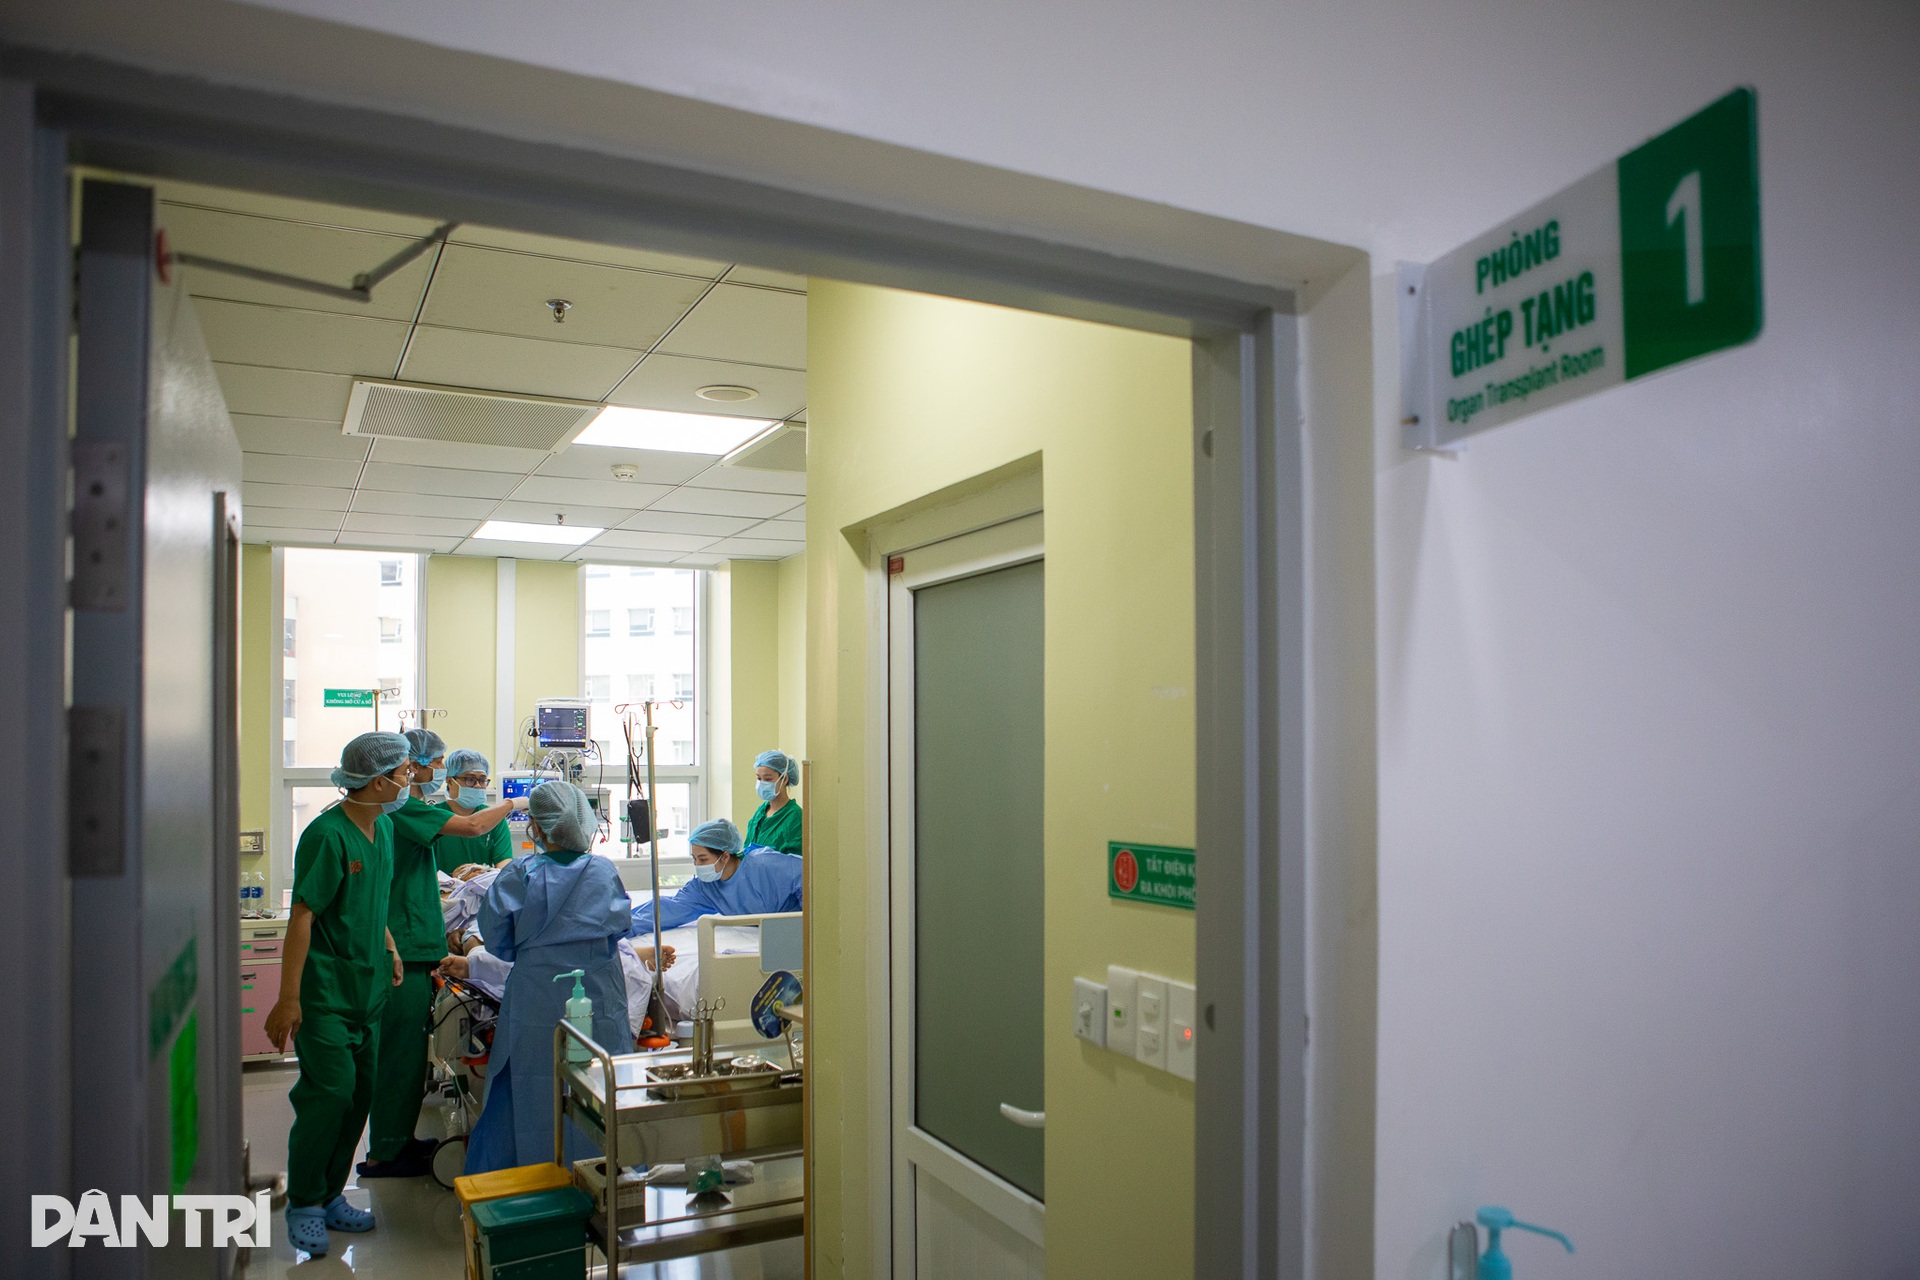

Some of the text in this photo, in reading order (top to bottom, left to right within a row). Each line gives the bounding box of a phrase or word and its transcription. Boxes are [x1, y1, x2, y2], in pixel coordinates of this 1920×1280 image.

[1476, 219, 1560, 294] PHÒNG
[1665, 170, 1704, 305] 1
[1451, 271, 1595, 378] GHÉP TẠNG
[1447, 346, 1606, 424] Organ Transplant Room
[1140, 880, 1153, 895] RA
